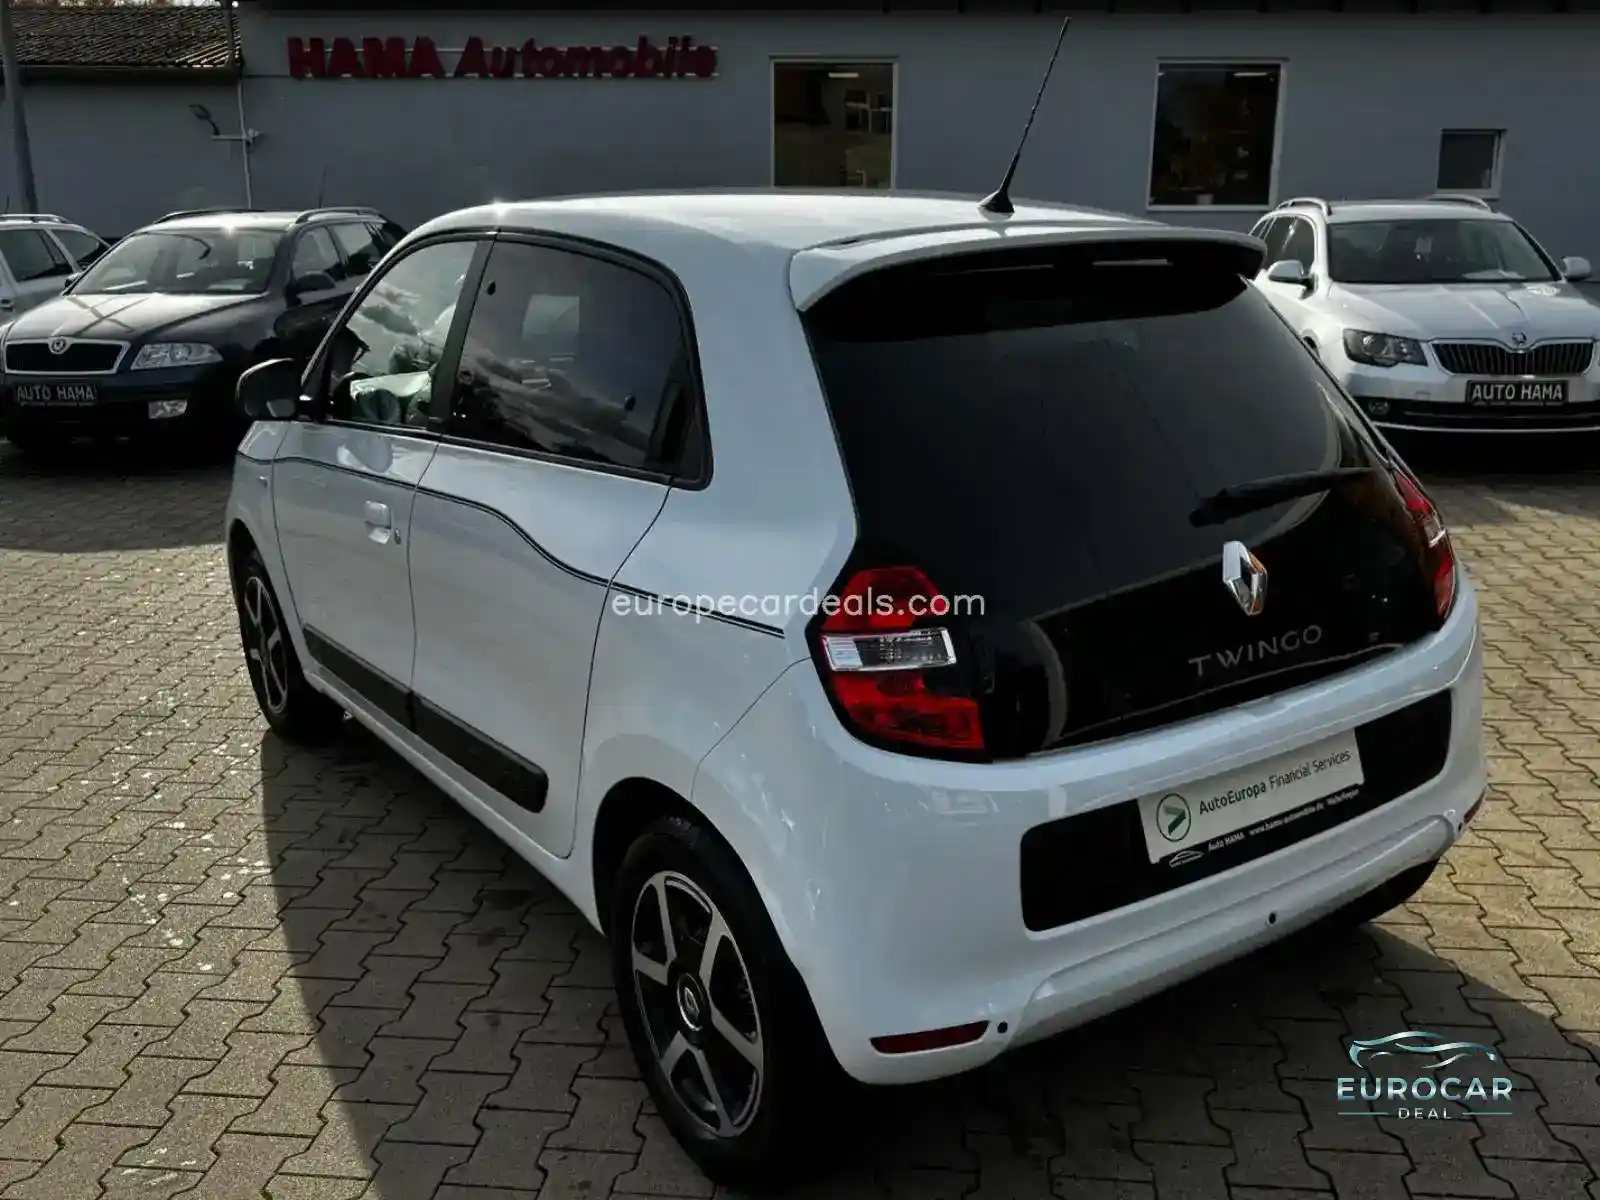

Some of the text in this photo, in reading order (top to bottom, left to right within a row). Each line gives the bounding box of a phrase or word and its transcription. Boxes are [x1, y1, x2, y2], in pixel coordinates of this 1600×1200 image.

[287, 35, 719, 79] HAMA Automobile
[17, 384, 95, 401] AUTO HAMA
[1472, 383, 1563, 400] AUTO HAMA
[1188, 624, 1322, 677] TWINGO
[1199, 750, 1351, 816] AutoEuropa Financial Services
[1208, 840, 1224, 851] Auto
[1225, 833, 1245, 846] HAMA
